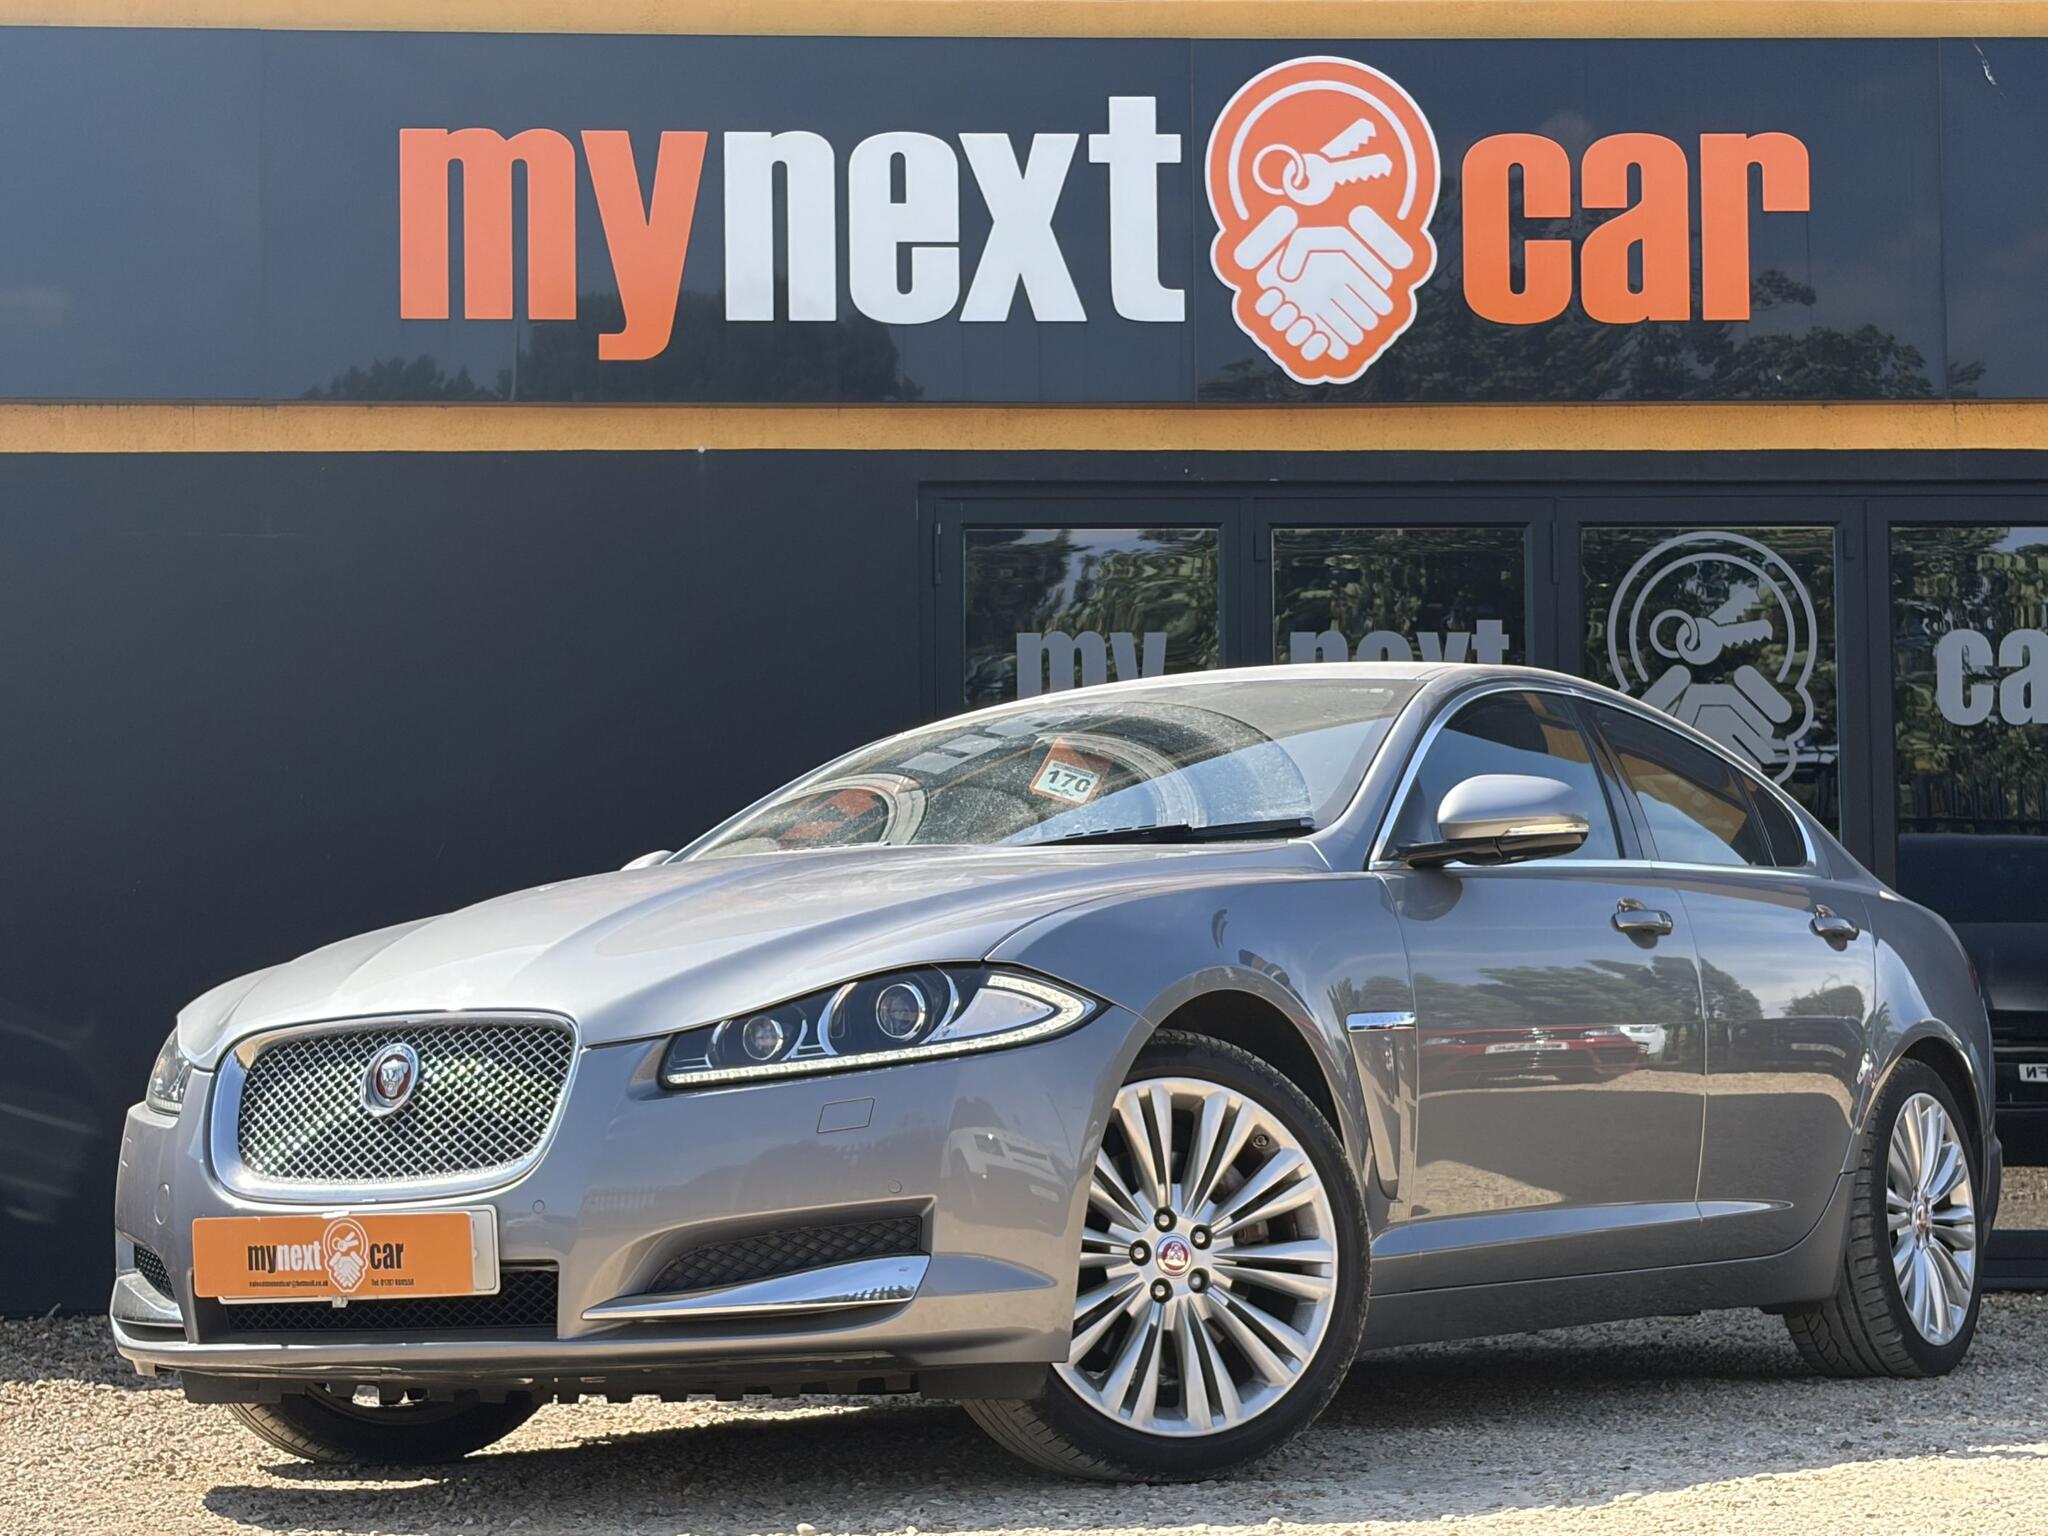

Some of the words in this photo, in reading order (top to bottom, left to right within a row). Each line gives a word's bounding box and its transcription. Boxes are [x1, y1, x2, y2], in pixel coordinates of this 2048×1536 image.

[1461, 132, 1810, 325] car
[1048, 770, 1091, 792] 170
[370, 1243, 404, 1269] car
